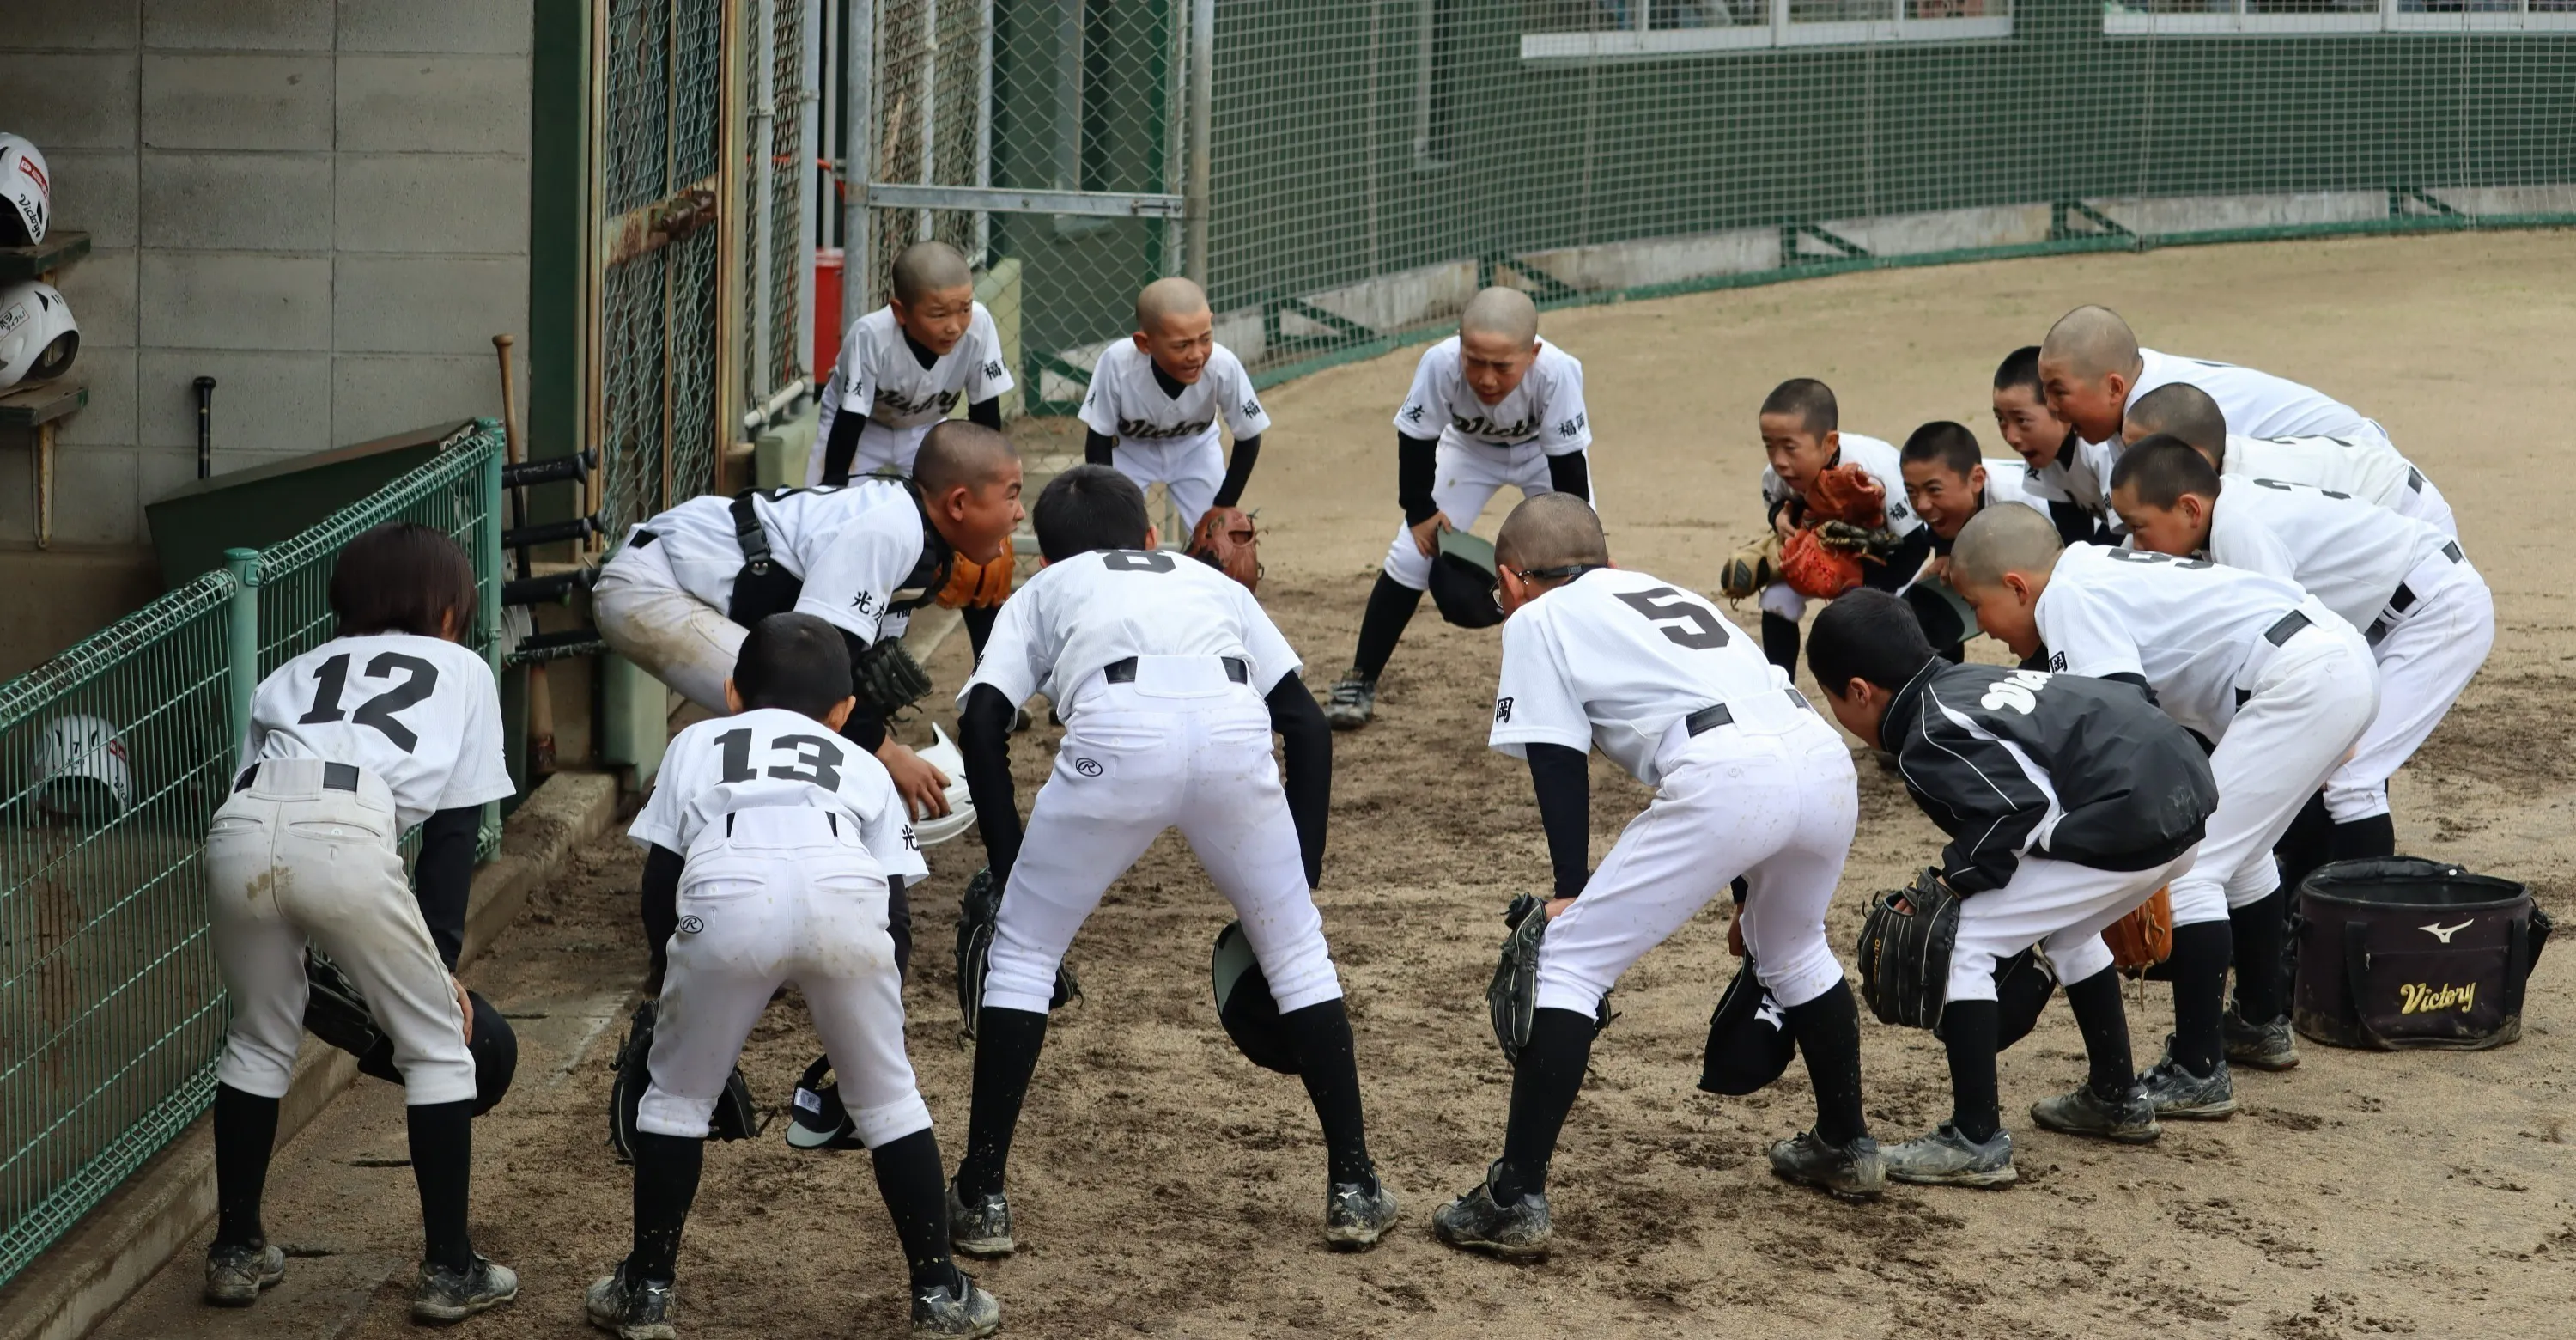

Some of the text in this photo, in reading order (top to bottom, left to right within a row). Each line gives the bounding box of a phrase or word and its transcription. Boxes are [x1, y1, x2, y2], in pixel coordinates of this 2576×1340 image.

[19, 193, 41, 234] Victory
[983, 357, 1006, 381] 福
[1242, 399, 1261, 420] 福
[1402, 402, 1425, 424] 友
[1558, 411, 1585, 439] 福岡
[1890, 497, 1909, 522] 福
[849, 590, 885, 627] 光友
[1612, 587, 1731, 650] 5
[2049, 650, 2068, 674] 岡
[297, 651, 440, 755] 12
[1495, 697, 1515, 724] 岡
[714, 728, 845, 794] 13
[902, 824, 920, 851] 光
[2400, 982, 2476, 1014] Victory
